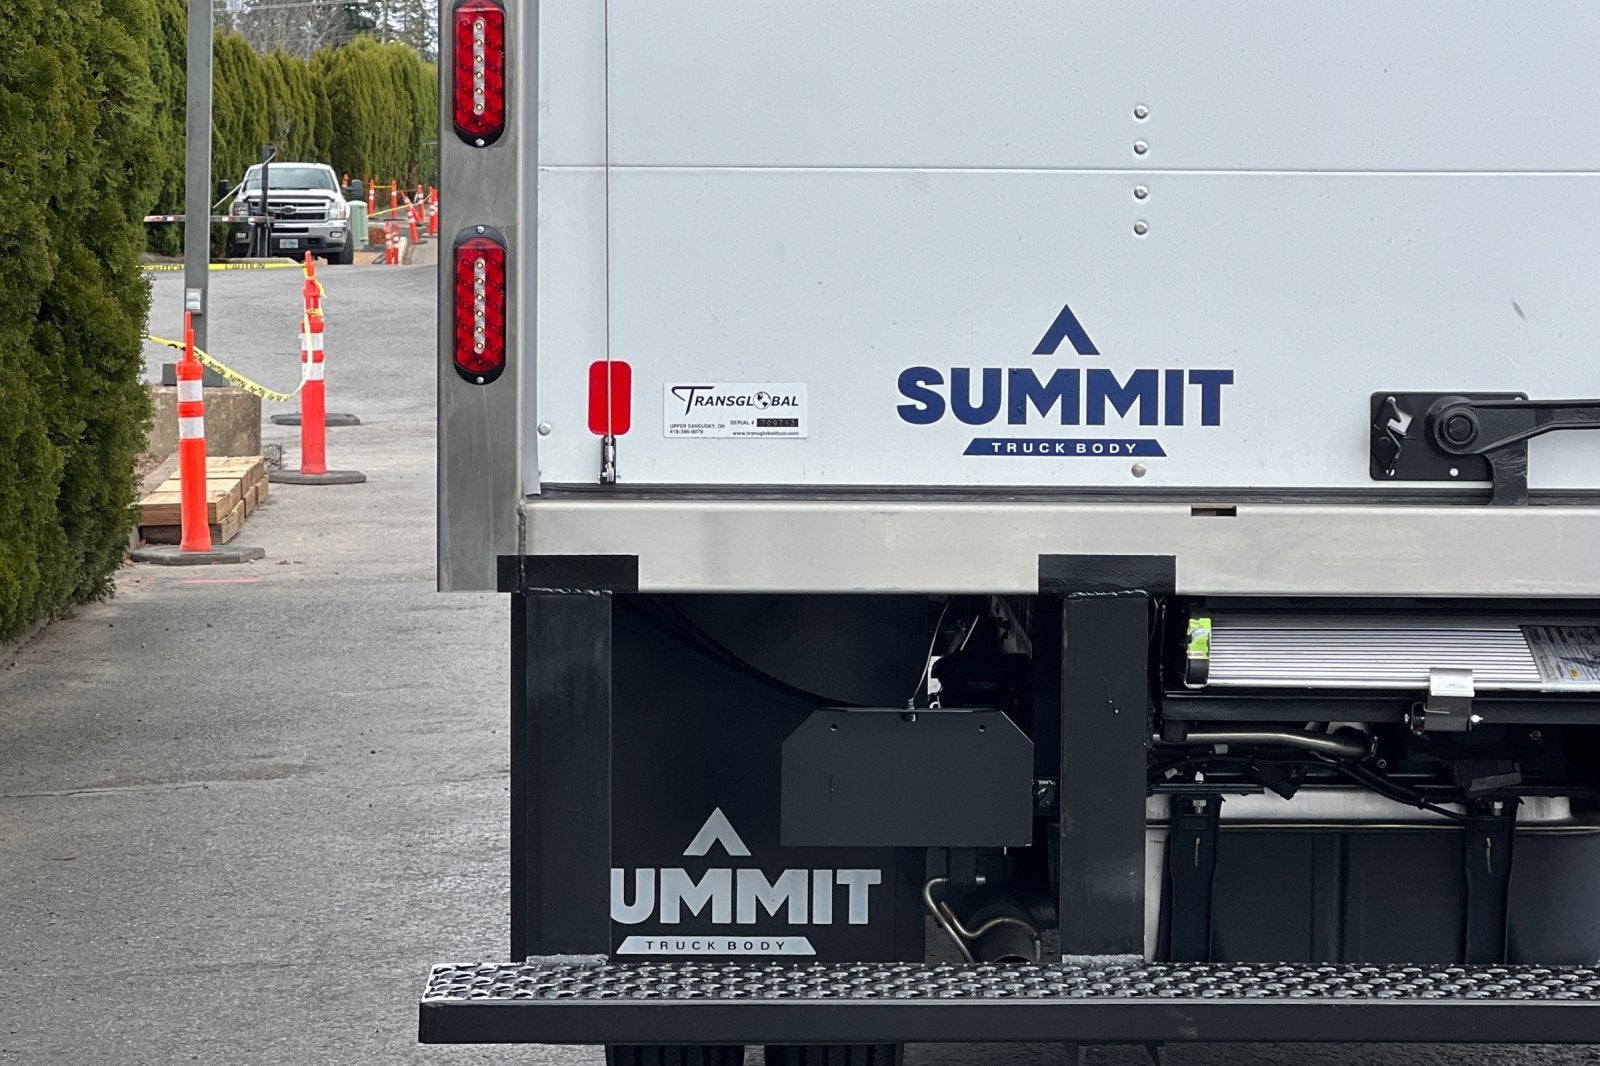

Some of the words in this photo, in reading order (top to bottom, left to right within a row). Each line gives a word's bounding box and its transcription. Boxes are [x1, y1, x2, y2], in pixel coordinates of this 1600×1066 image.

[671, 386, 799, 416] TRANSGLOBAL
[897, 366, 1234, 427] SUMMIT
[992, 442, 1065, 454] TRUCK
[1076, 442, 1137, 455] BODY
[610, 868, 882, 925] UMMIT
[646, 940, 716, 951] TRUCK
[728, 940, 785, 951] BODY
